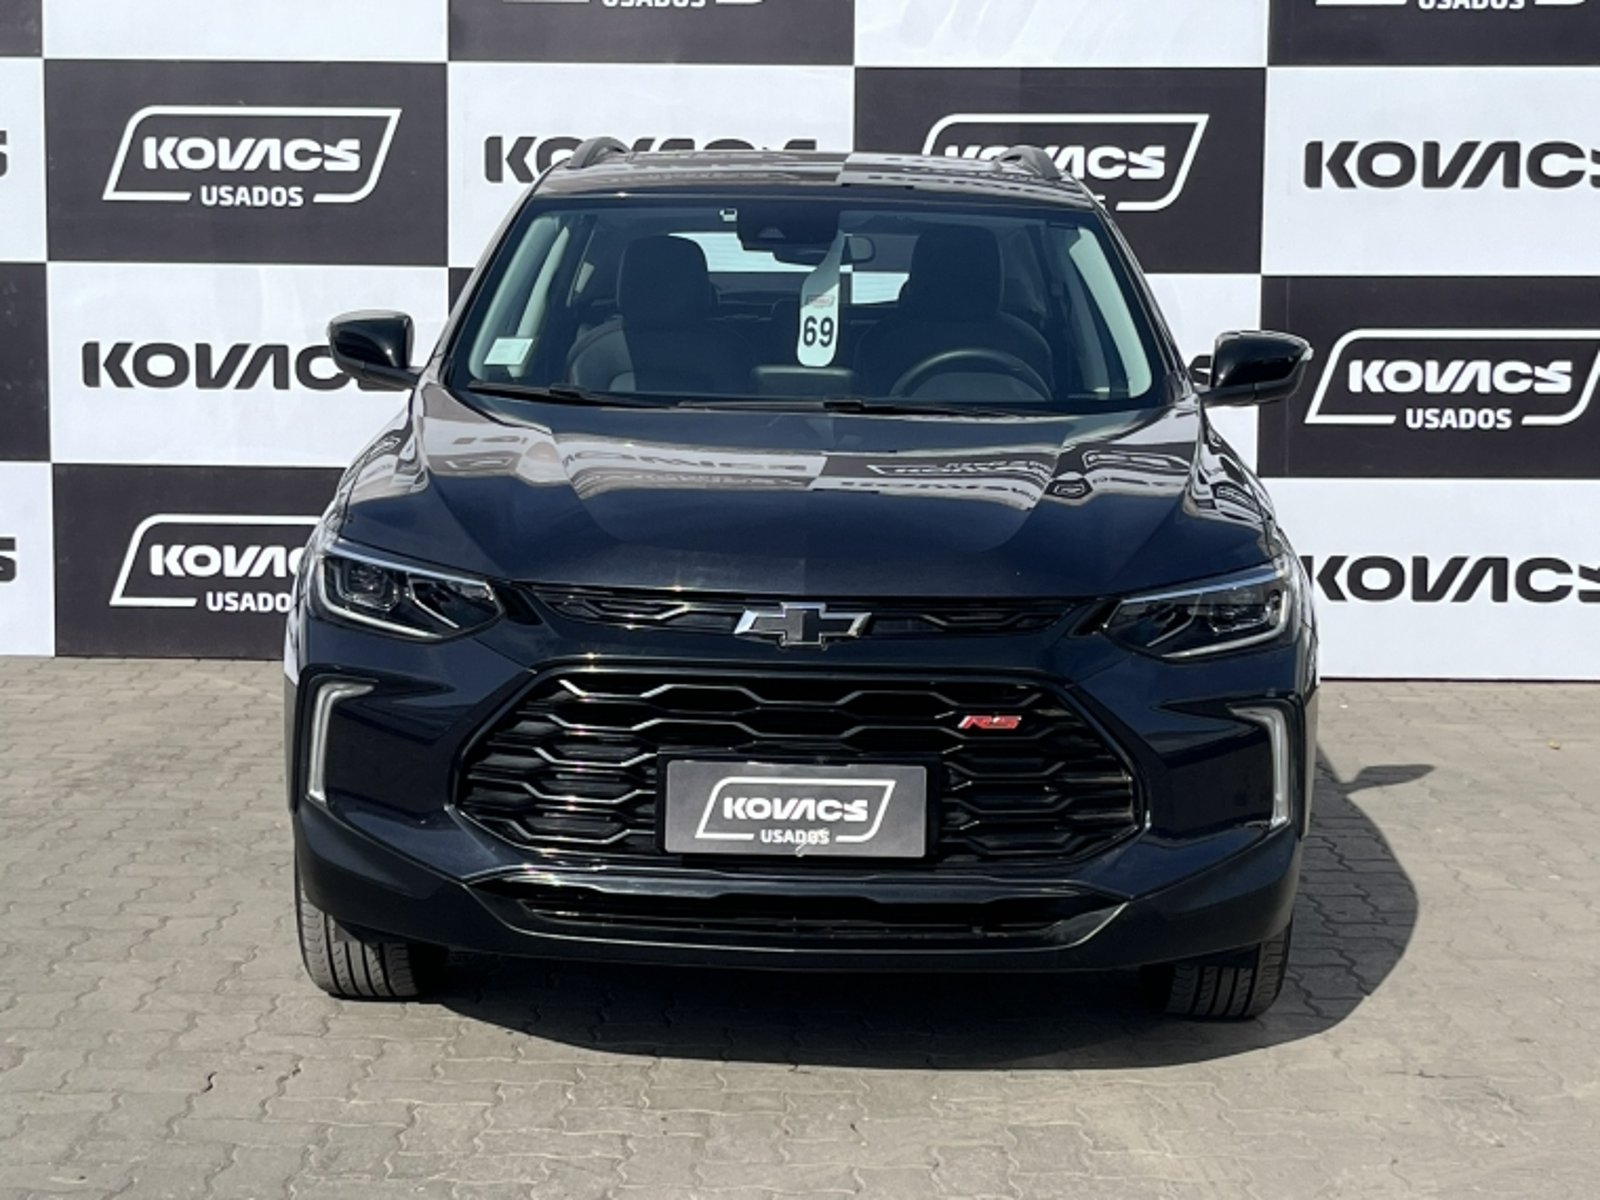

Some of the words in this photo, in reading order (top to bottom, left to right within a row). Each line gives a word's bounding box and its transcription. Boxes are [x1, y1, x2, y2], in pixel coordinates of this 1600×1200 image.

[144, 137, 360, 171] KOVACS
[1305, 141, 1600, 189] KOVAC
[201, 186, 303, 207] USADOS
[804, 315, 834, 347] 69
[82, 341, 406, 391] KOVAC
[1349, 359, 1572, 393] KOVACS
[1406, 409, 1511, 430] USADOS
[151, 545, 306, 577] KOVA
[207, 592, 292, 613] USADO
[958, 715, 1021, 729] RS
[724, 797, 867, 821] KOVACS
[761, 828, 830, 845] USADOS
